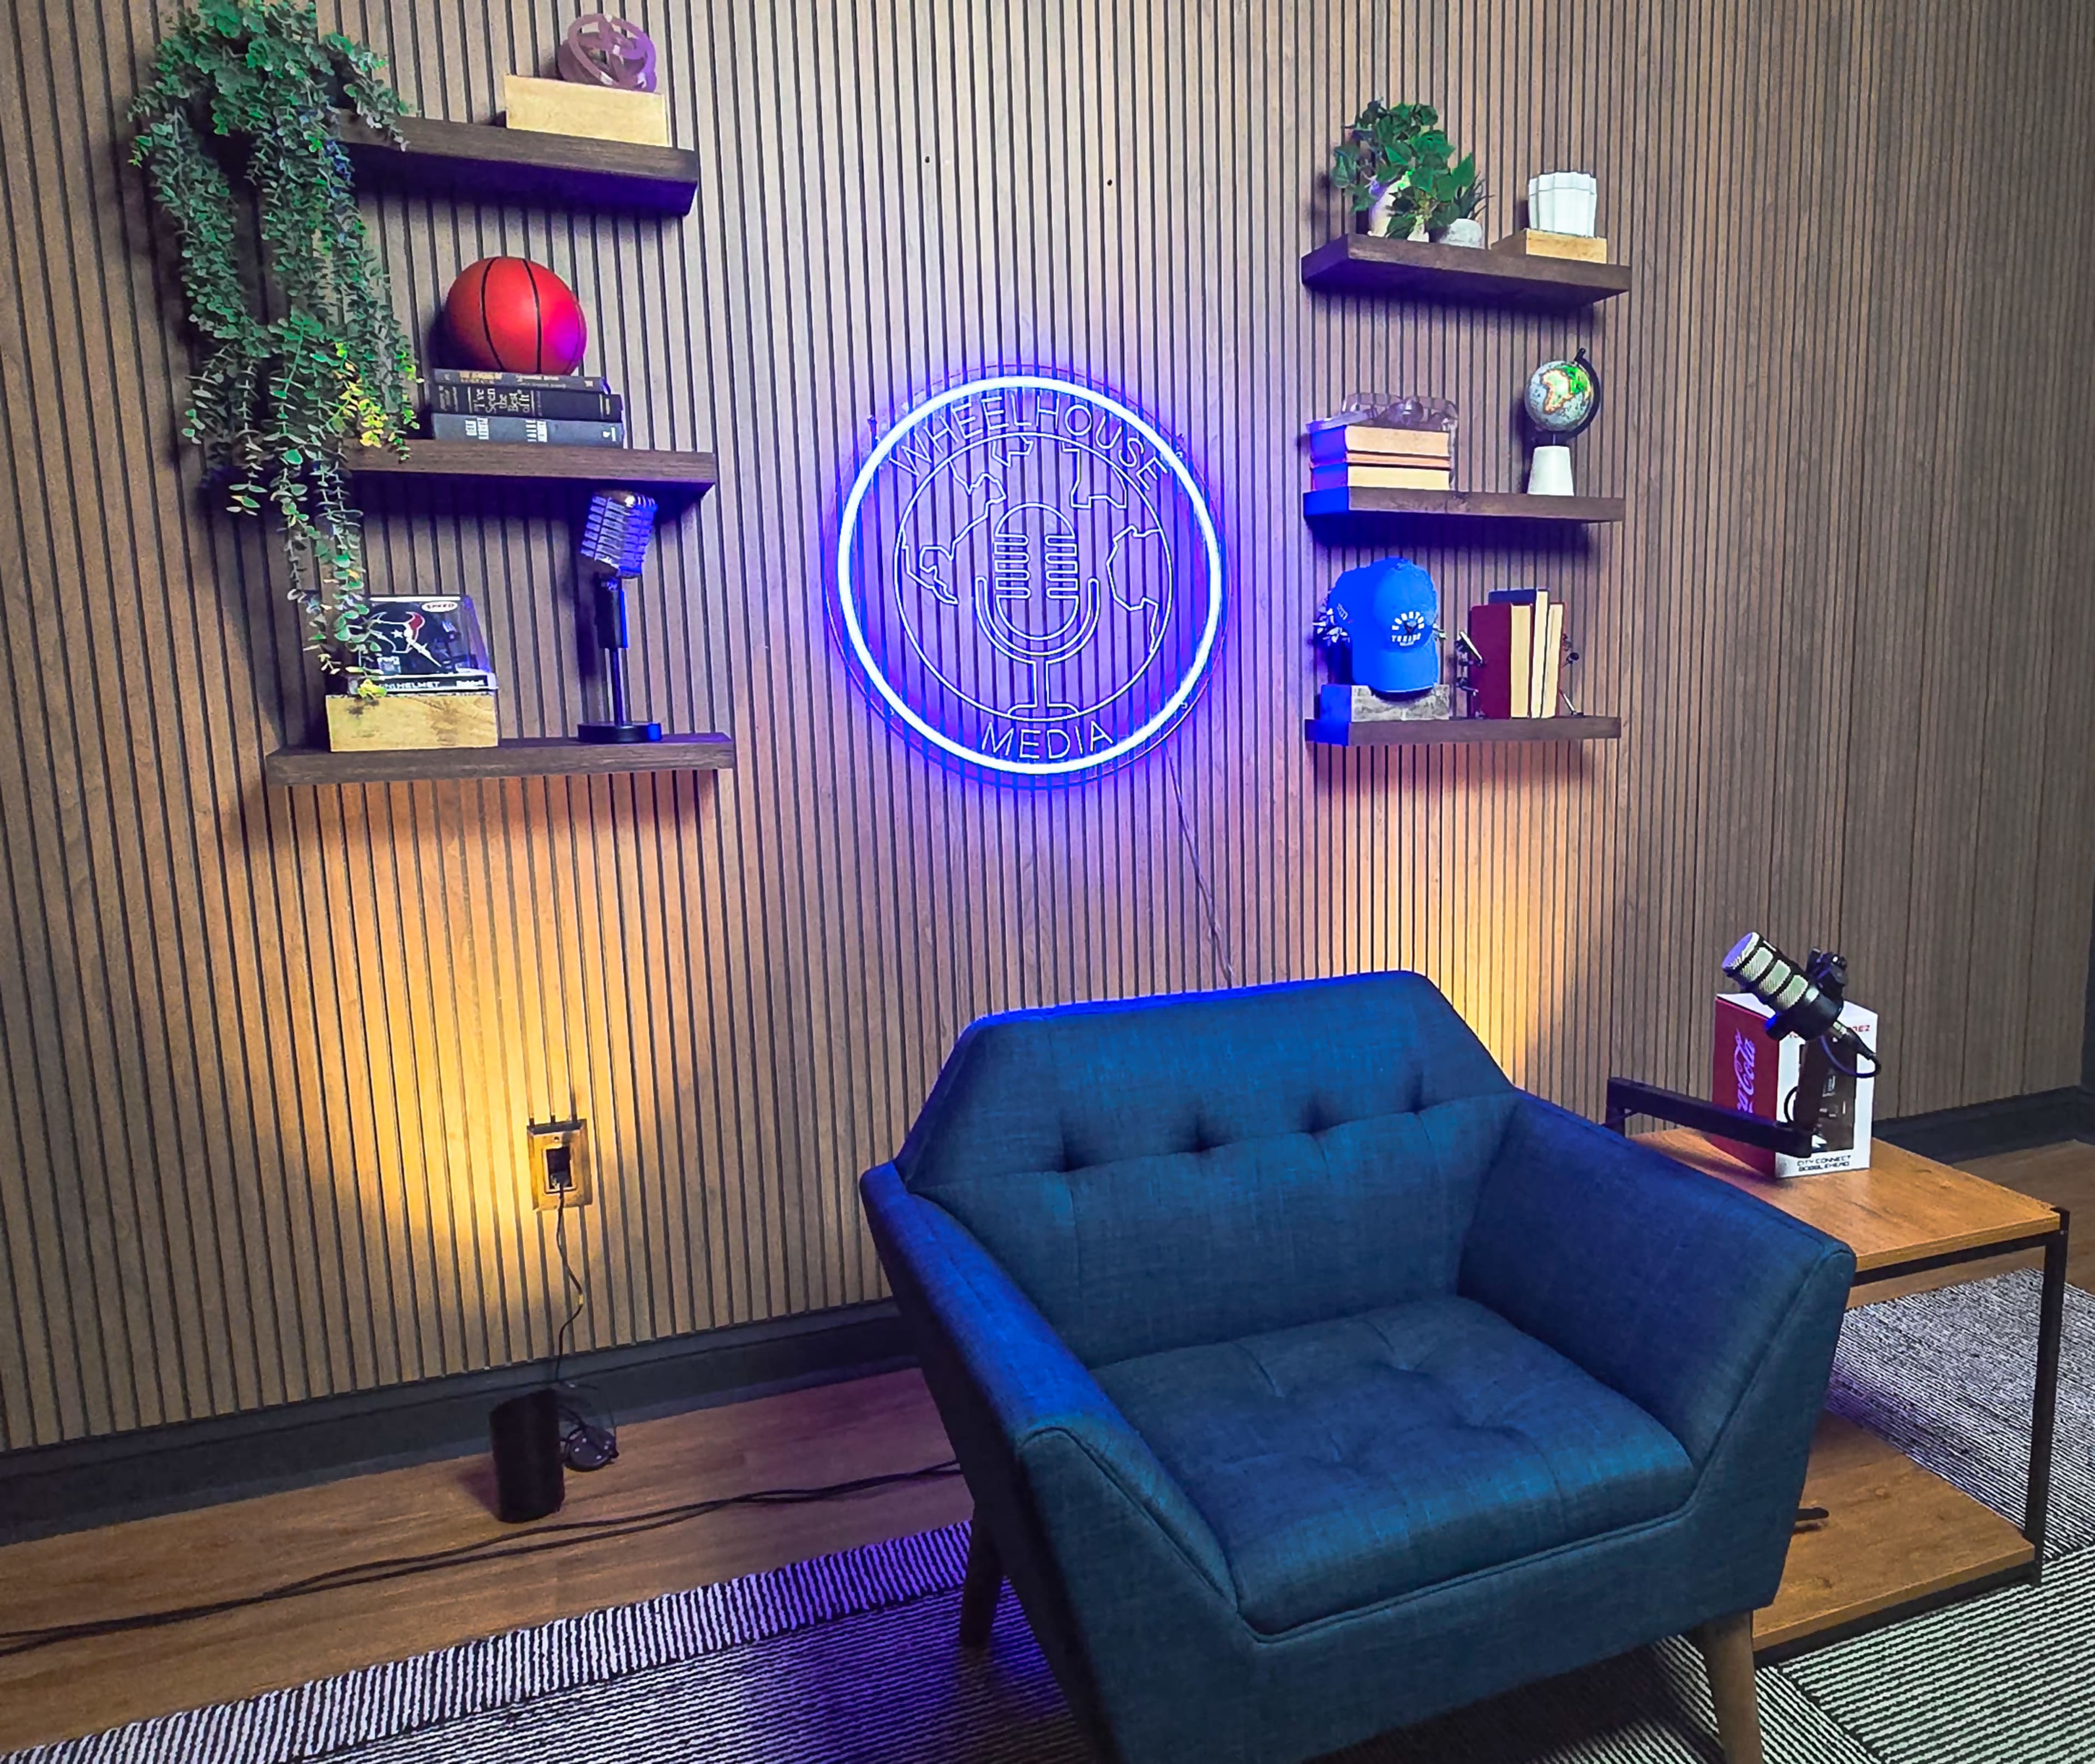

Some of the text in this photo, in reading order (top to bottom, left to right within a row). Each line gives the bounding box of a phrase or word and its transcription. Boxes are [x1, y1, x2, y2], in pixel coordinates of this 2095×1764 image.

[888, 394, 1169, 491] WHEELHOUSE
[981, 720, 1114, 759] MEDIA
[1798, 1161, 1850, 1172] BOBBLEHEAD
[1816, 1155, 1851, 1164] CONNECT
